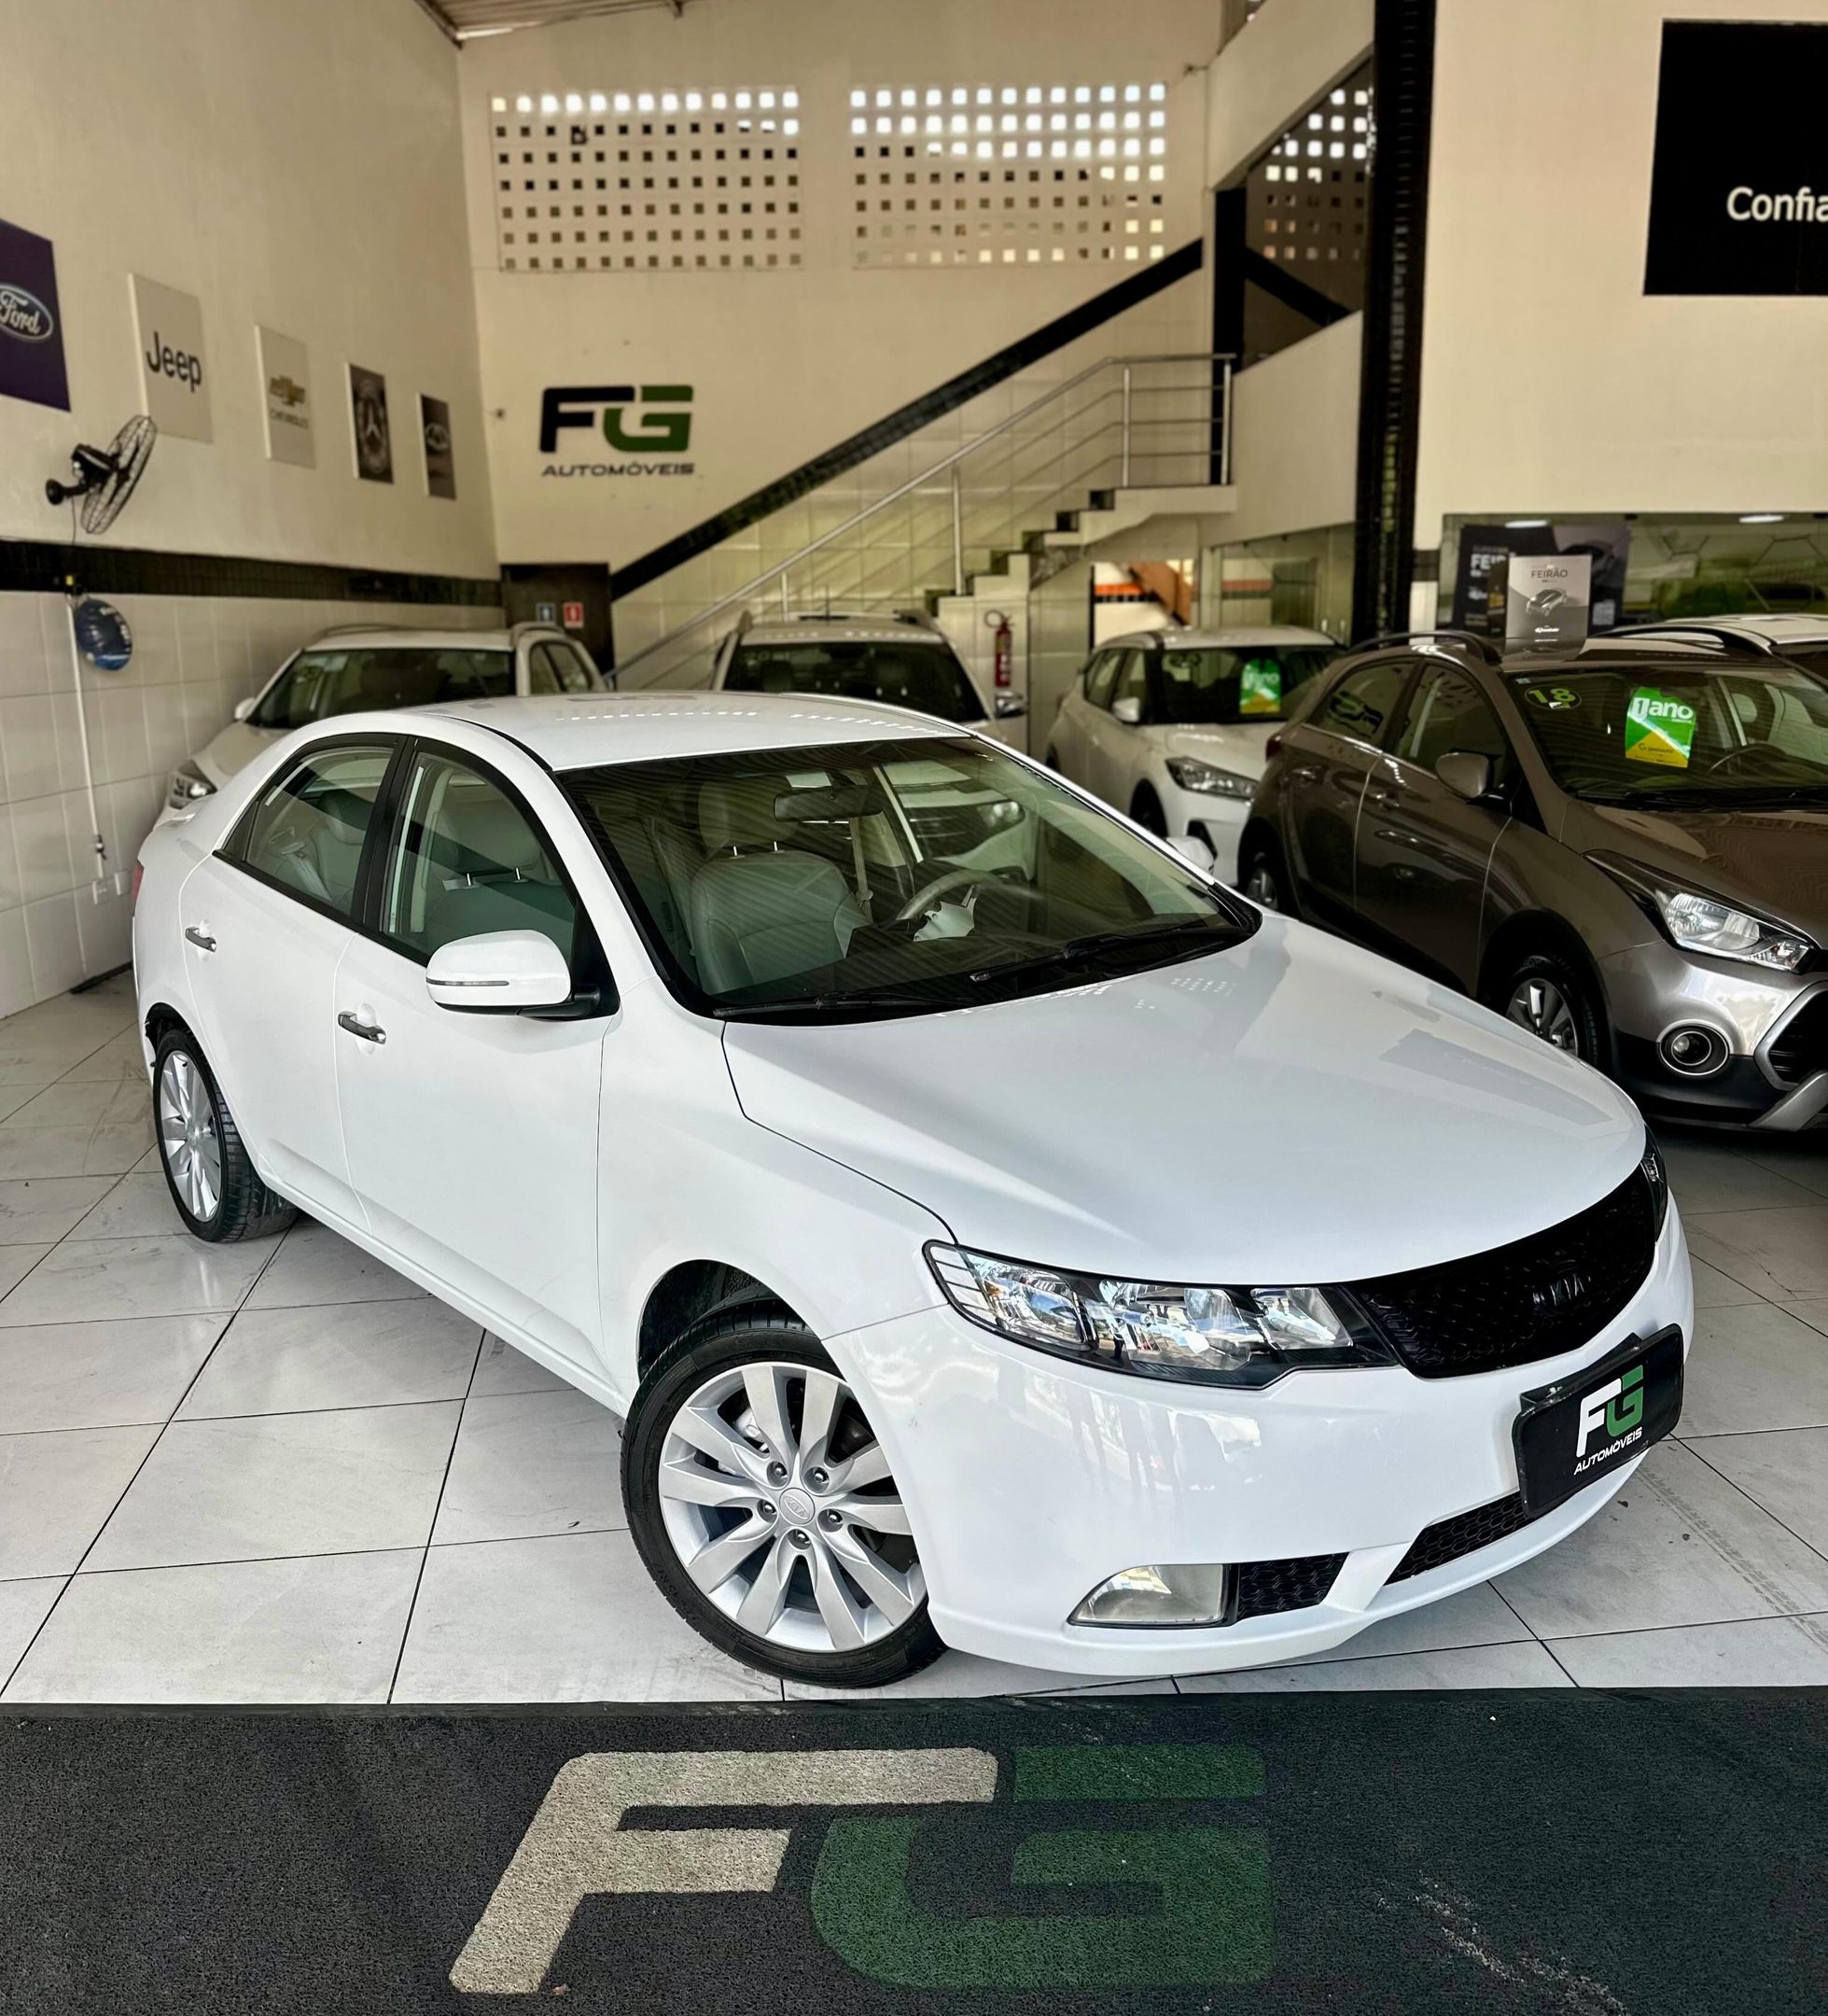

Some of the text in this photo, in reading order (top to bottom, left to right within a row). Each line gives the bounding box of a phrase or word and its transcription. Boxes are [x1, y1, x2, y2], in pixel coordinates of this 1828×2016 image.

[1727, 186, 1828, 222] Confia
[0, 290, 41, 334] Ford
[147, 330, 202, 393] Jeep
[539, 385, 693, 453] FG
[541, 461, 695, 477] AUTOMÓVEIS
[1530, 567, 1569, 579] FEIRÃO
[1528, 687, 1576, 704] 18
[1549, 1273, 1584, 1307] KIA
[1576, 1365, 1643, 1458] FG
[1573, 1427, 1642, 1476] AUTOMÓVEIS
[448, 1743, 1275, 1995] FG
